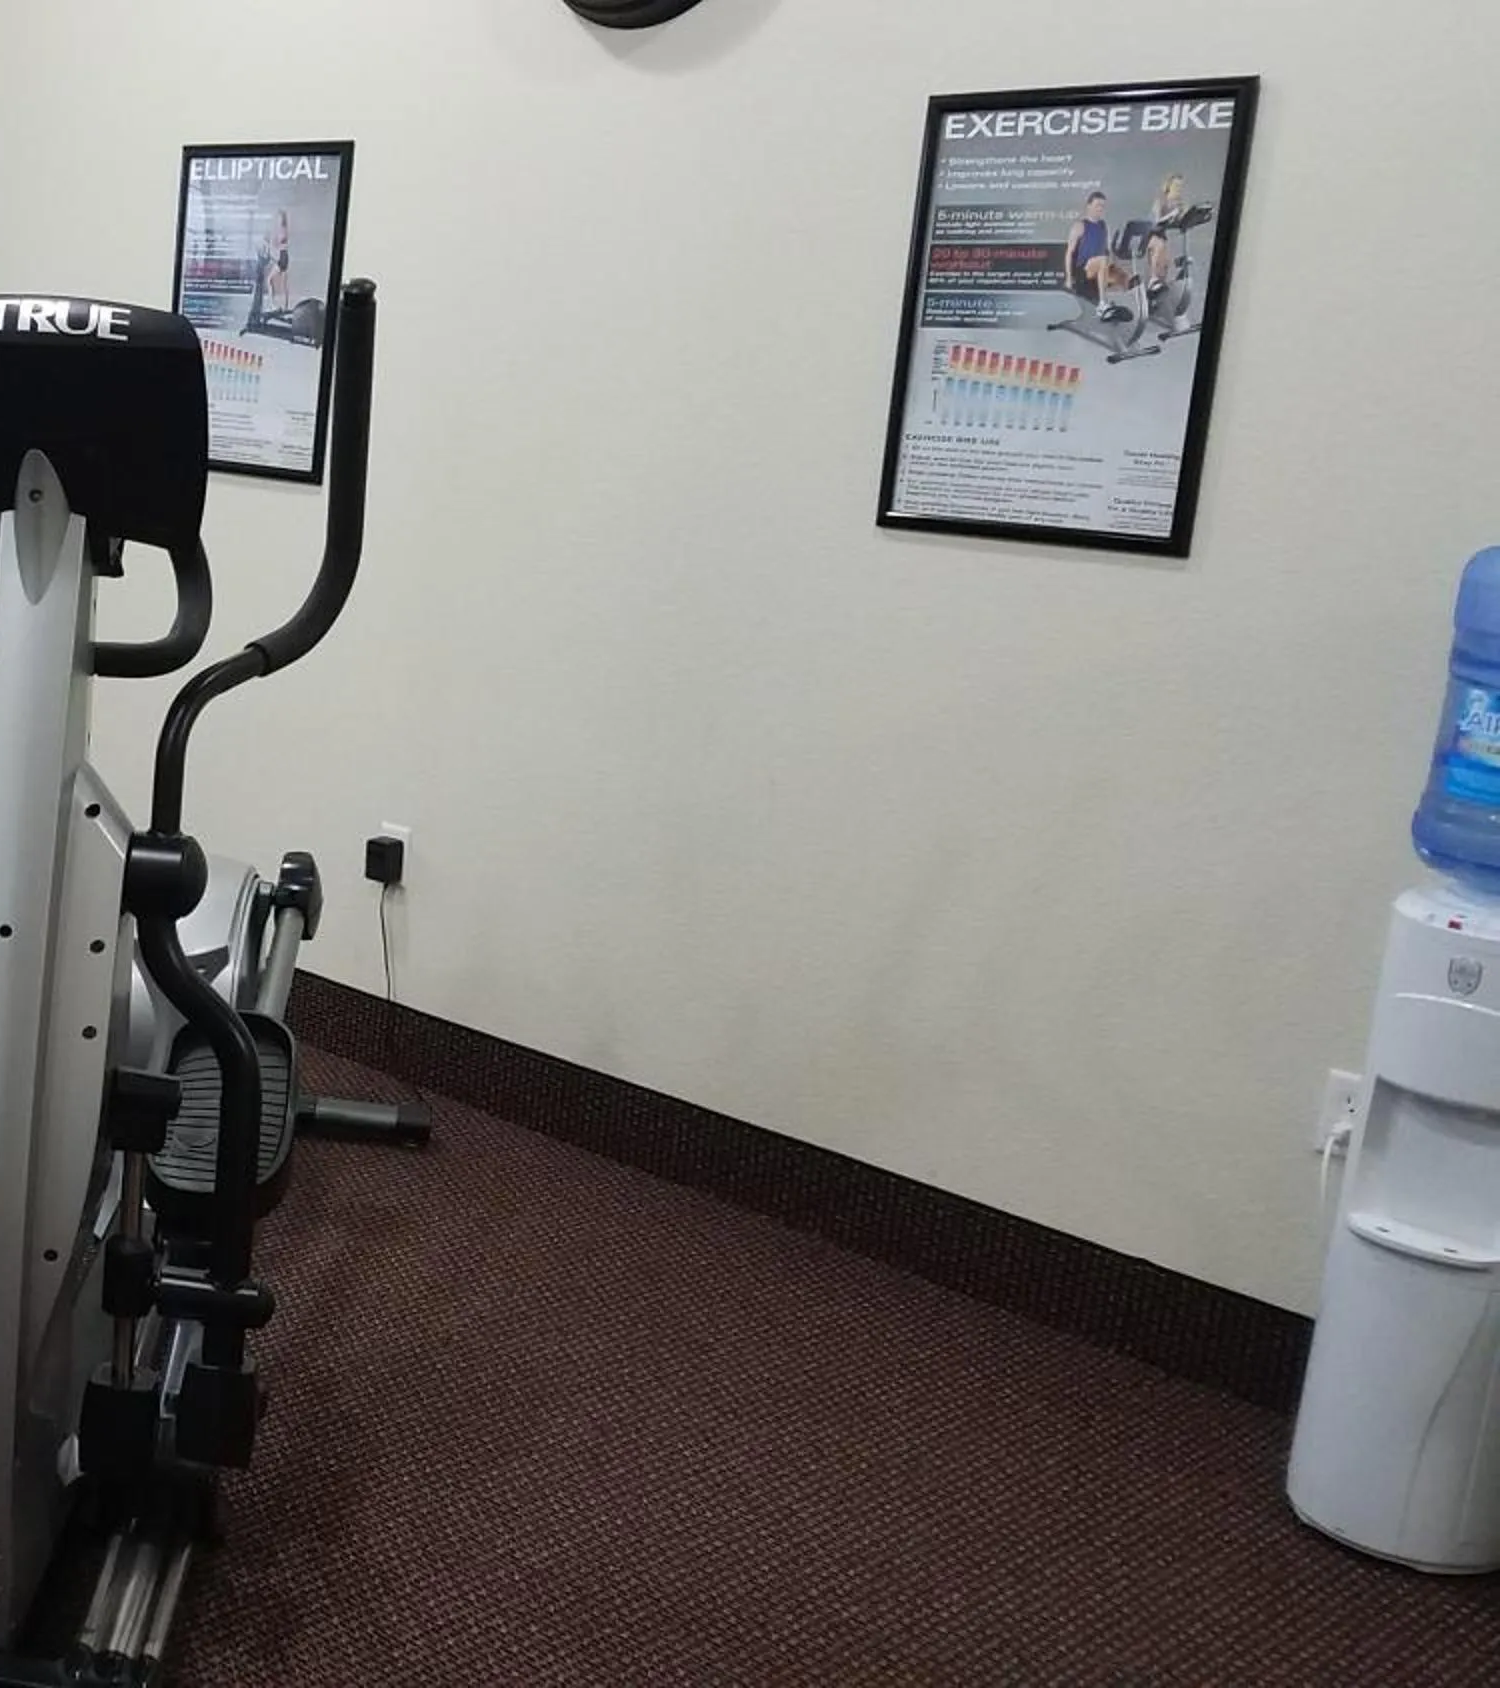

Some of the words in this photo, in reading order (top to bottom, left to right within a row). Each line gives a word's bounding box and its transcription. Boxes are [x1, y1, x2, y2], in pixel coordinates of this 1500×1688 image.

[945, 107, 1131, 140] EXERCISE
[1141, 101, 1235, 132] BIKE
[190, 156, 329, 181] ELLIPTICAL
